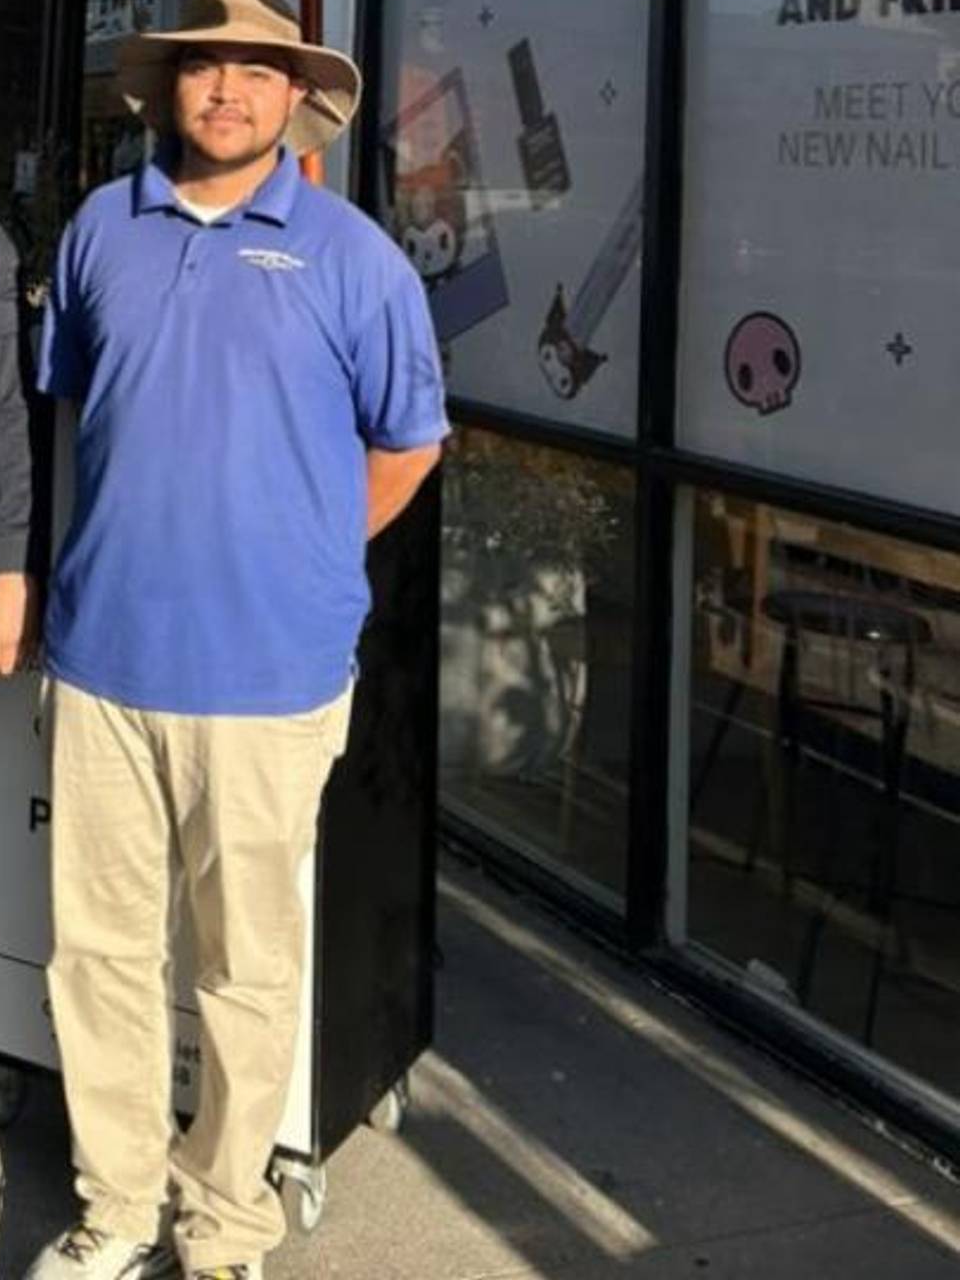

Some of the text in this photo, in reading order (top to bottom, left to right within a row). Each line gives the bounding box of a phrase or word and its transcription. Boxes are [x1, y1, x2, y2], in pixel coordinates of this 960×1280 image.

[815, 82, 911, 121] MEET
[778, 131, 949, 170] NEW NAIL
